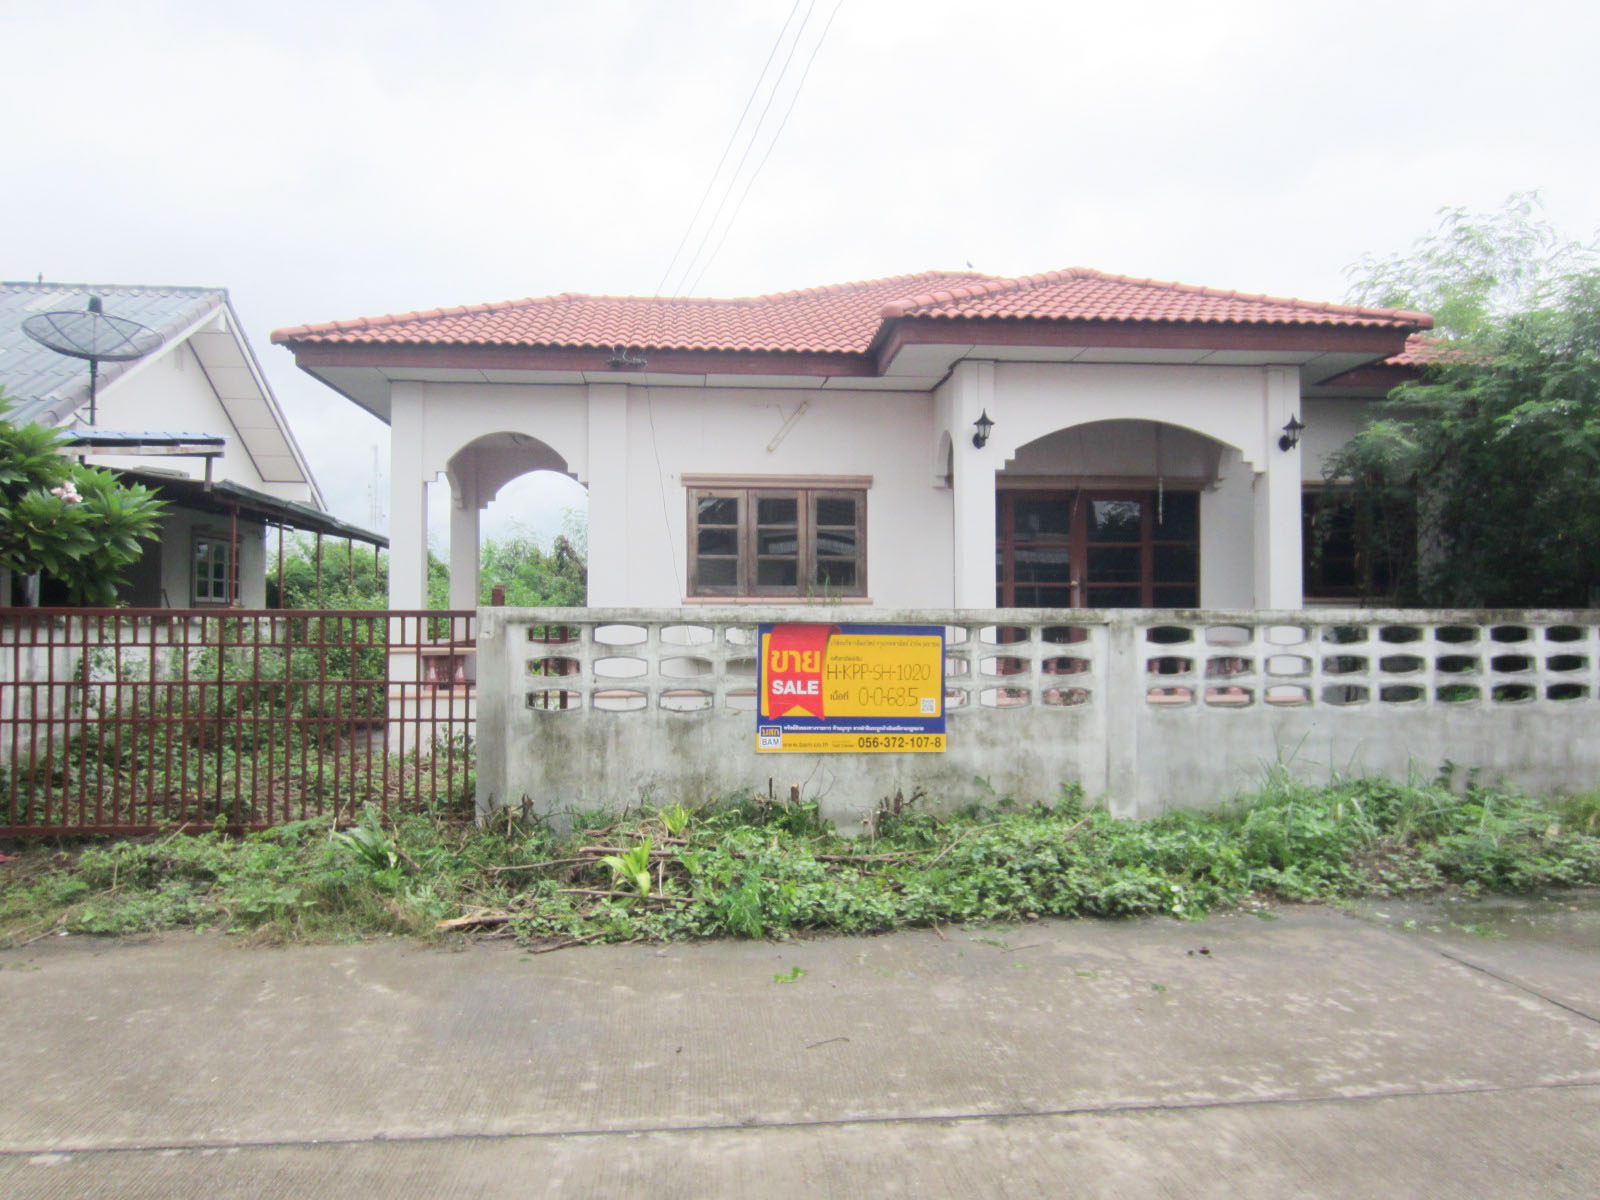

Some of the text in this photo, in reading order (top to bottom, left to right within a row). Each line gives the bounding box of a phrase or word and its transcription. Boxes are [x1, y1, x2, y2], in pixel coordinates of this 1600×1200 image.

[771, 650, 820, 673] ขาย
[771, 679, 820, 695] SALE
[761, 738, 780, 747] BAM
[857, 736, 942, 749] 056-372-107-8
